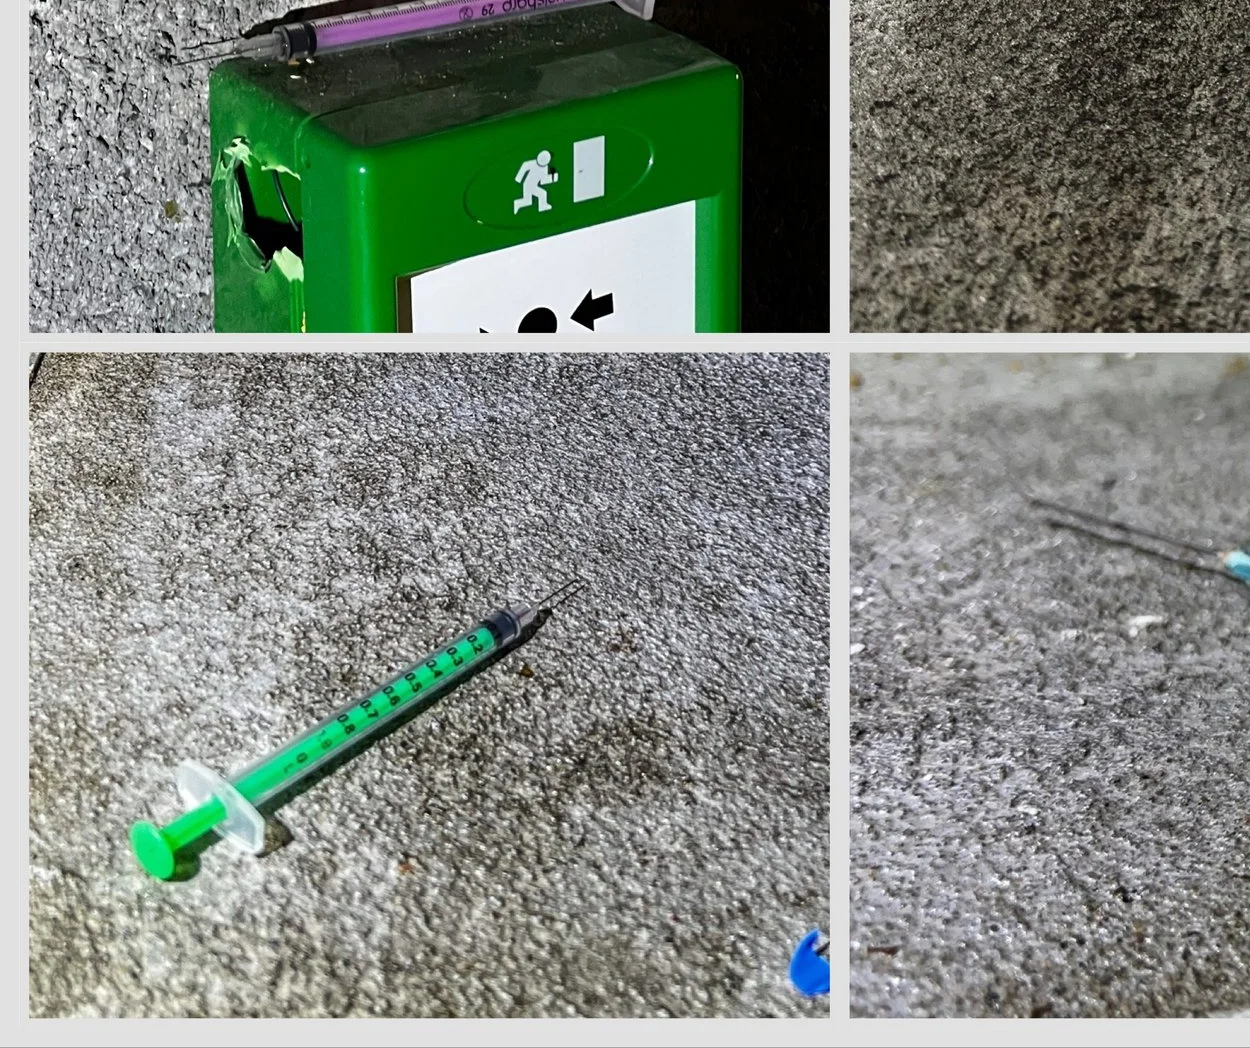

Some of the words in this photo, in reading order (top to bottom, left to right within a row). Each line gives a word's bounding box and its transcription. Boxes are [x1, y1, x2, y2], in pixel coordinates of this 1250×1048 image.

[481, 3, 495, 17] 29
[467, 634, 483, 654] 0.2
[447, 647, 463, 666] 0.3
[405, 673, 422, 692] 0.5
[383, 686, 400, 706] 0.6
[360, 700, 379, 717] 0.7
[337, 714, 356, 734] 0.8
